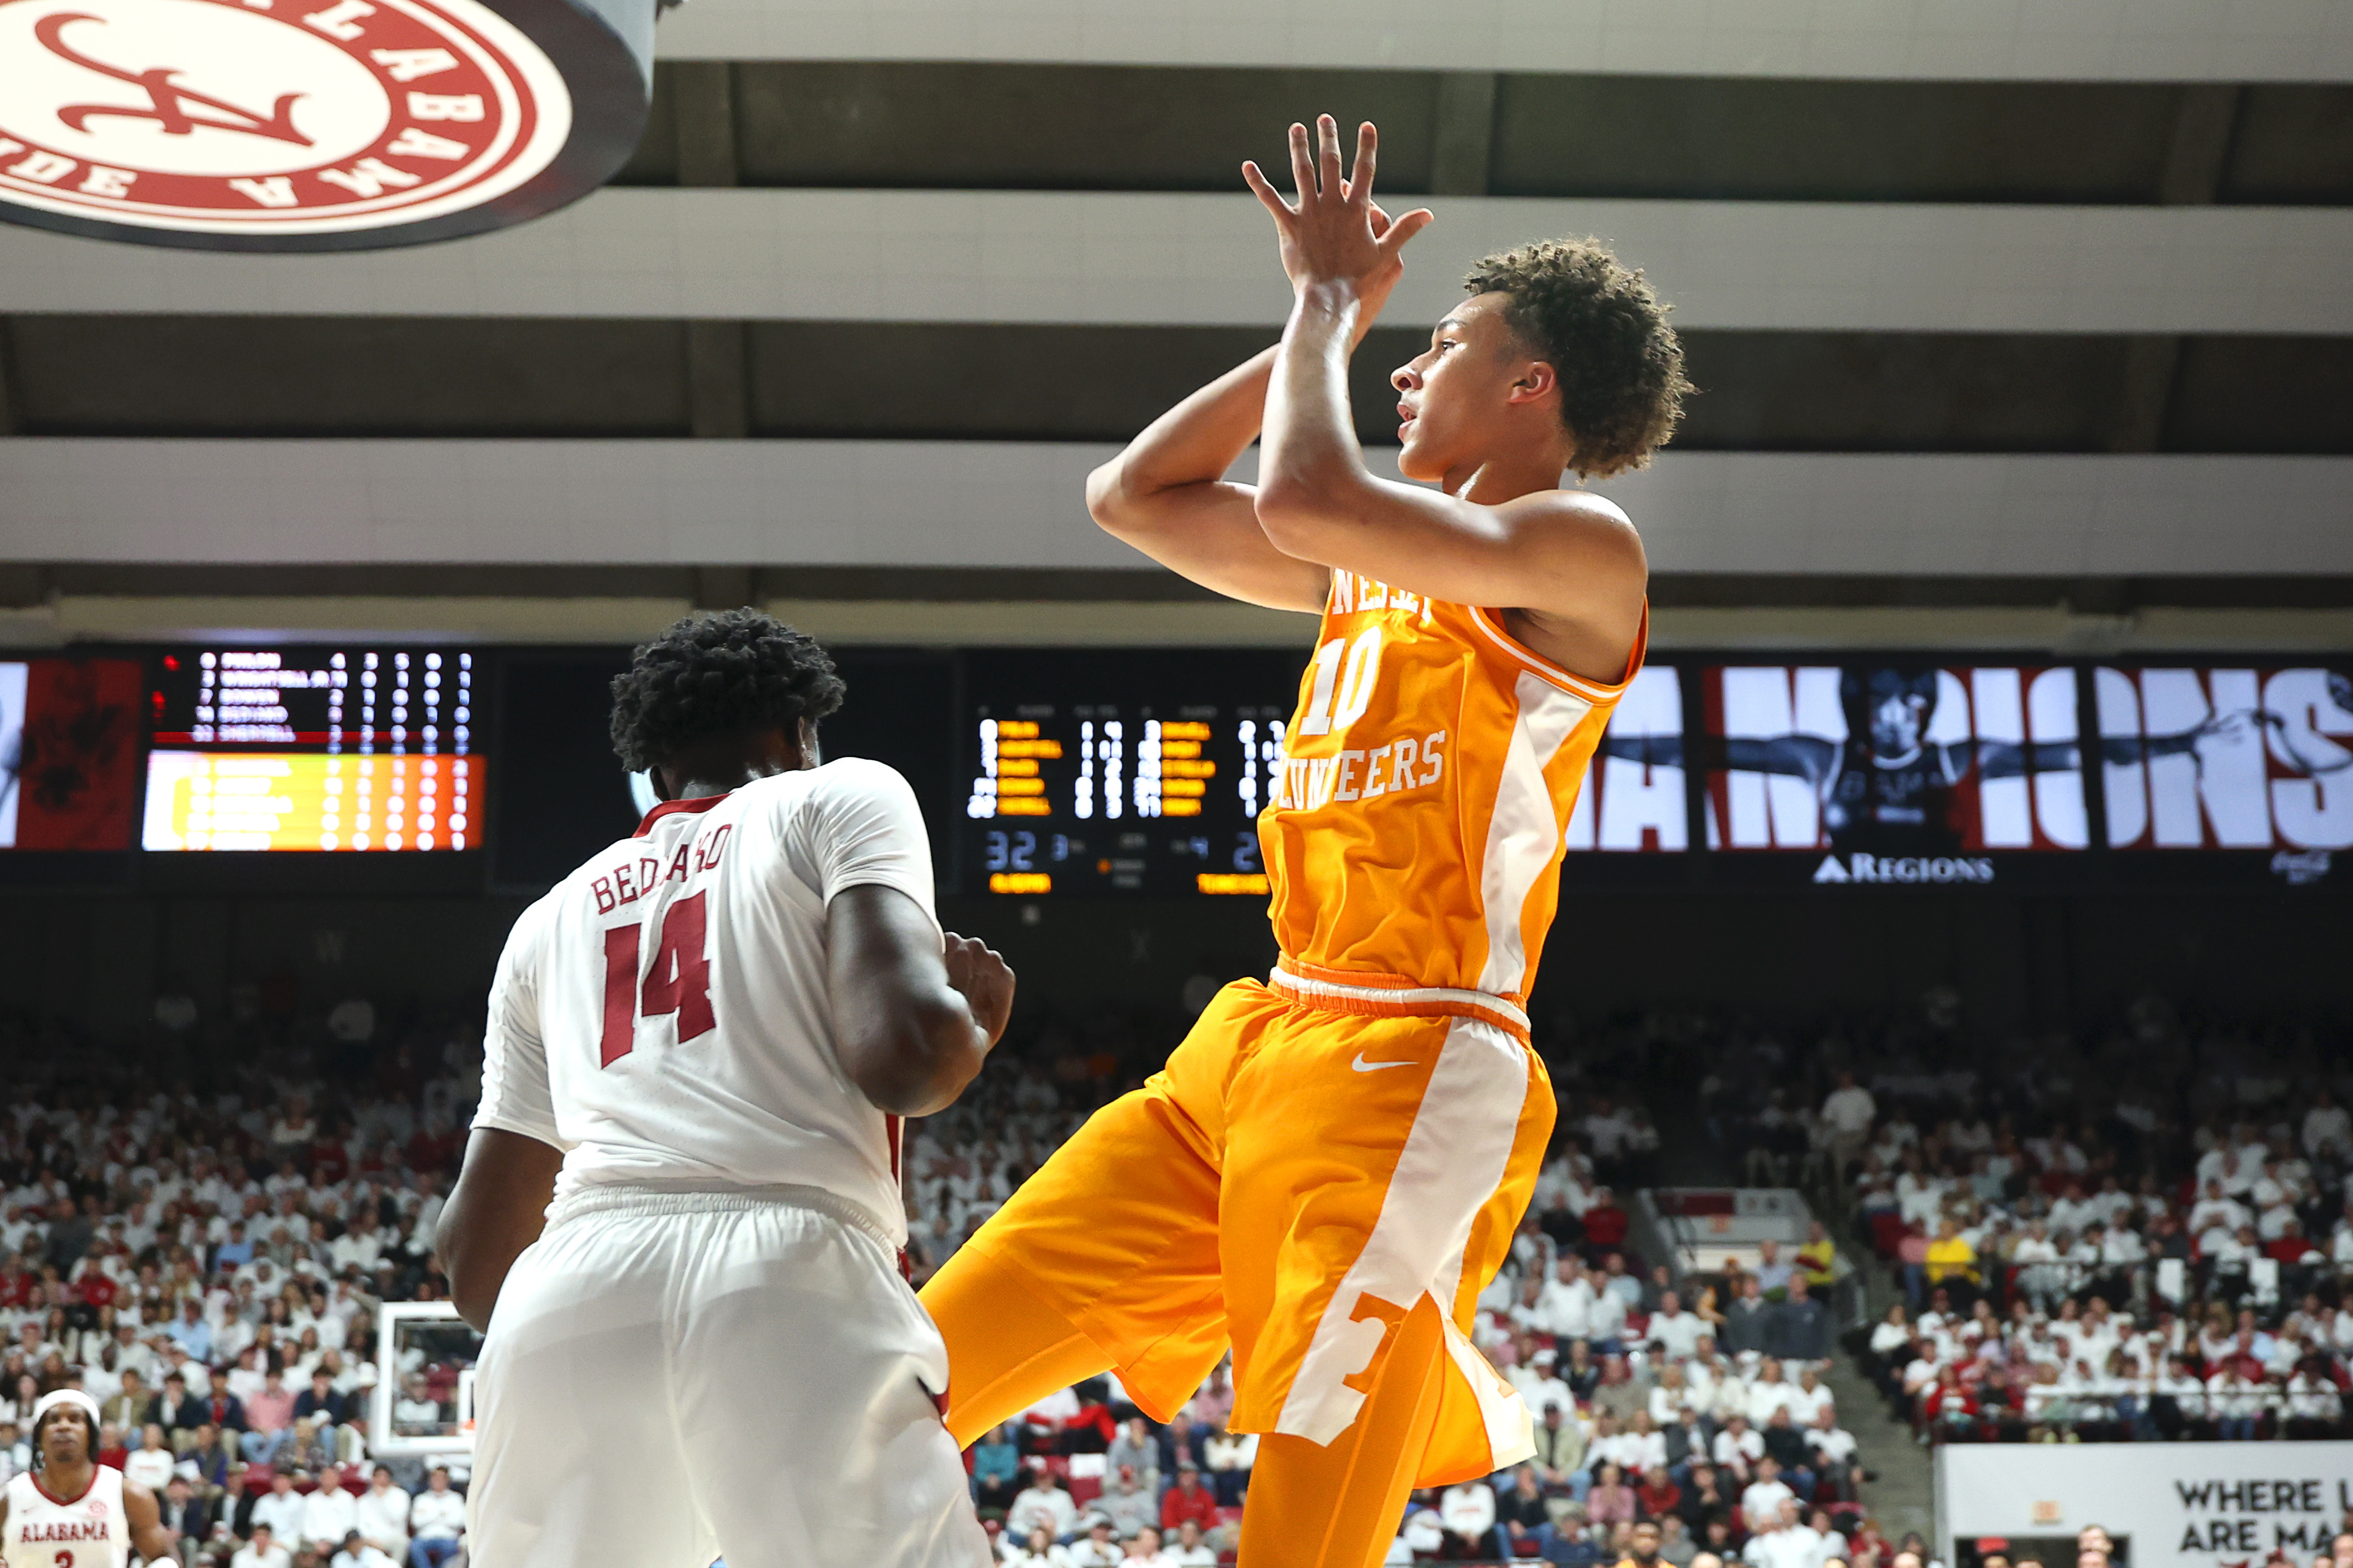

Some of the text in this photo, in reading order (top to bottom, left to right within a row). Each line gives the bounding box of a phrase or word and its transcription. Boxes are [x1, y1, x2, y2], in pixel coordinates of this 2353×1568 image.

[229, 0, 485, 208] LABAMA
[1299, 625, 1382, 736] 10
[985, 830, 1036, 870] 32
[601, 888, 717, 1070] 14
[2175, 1479, 2324, 1511] WHERE
[21, 1521, 109, 1542] ALABAMA
[2180, 1519, 2259, 1552] ARE
